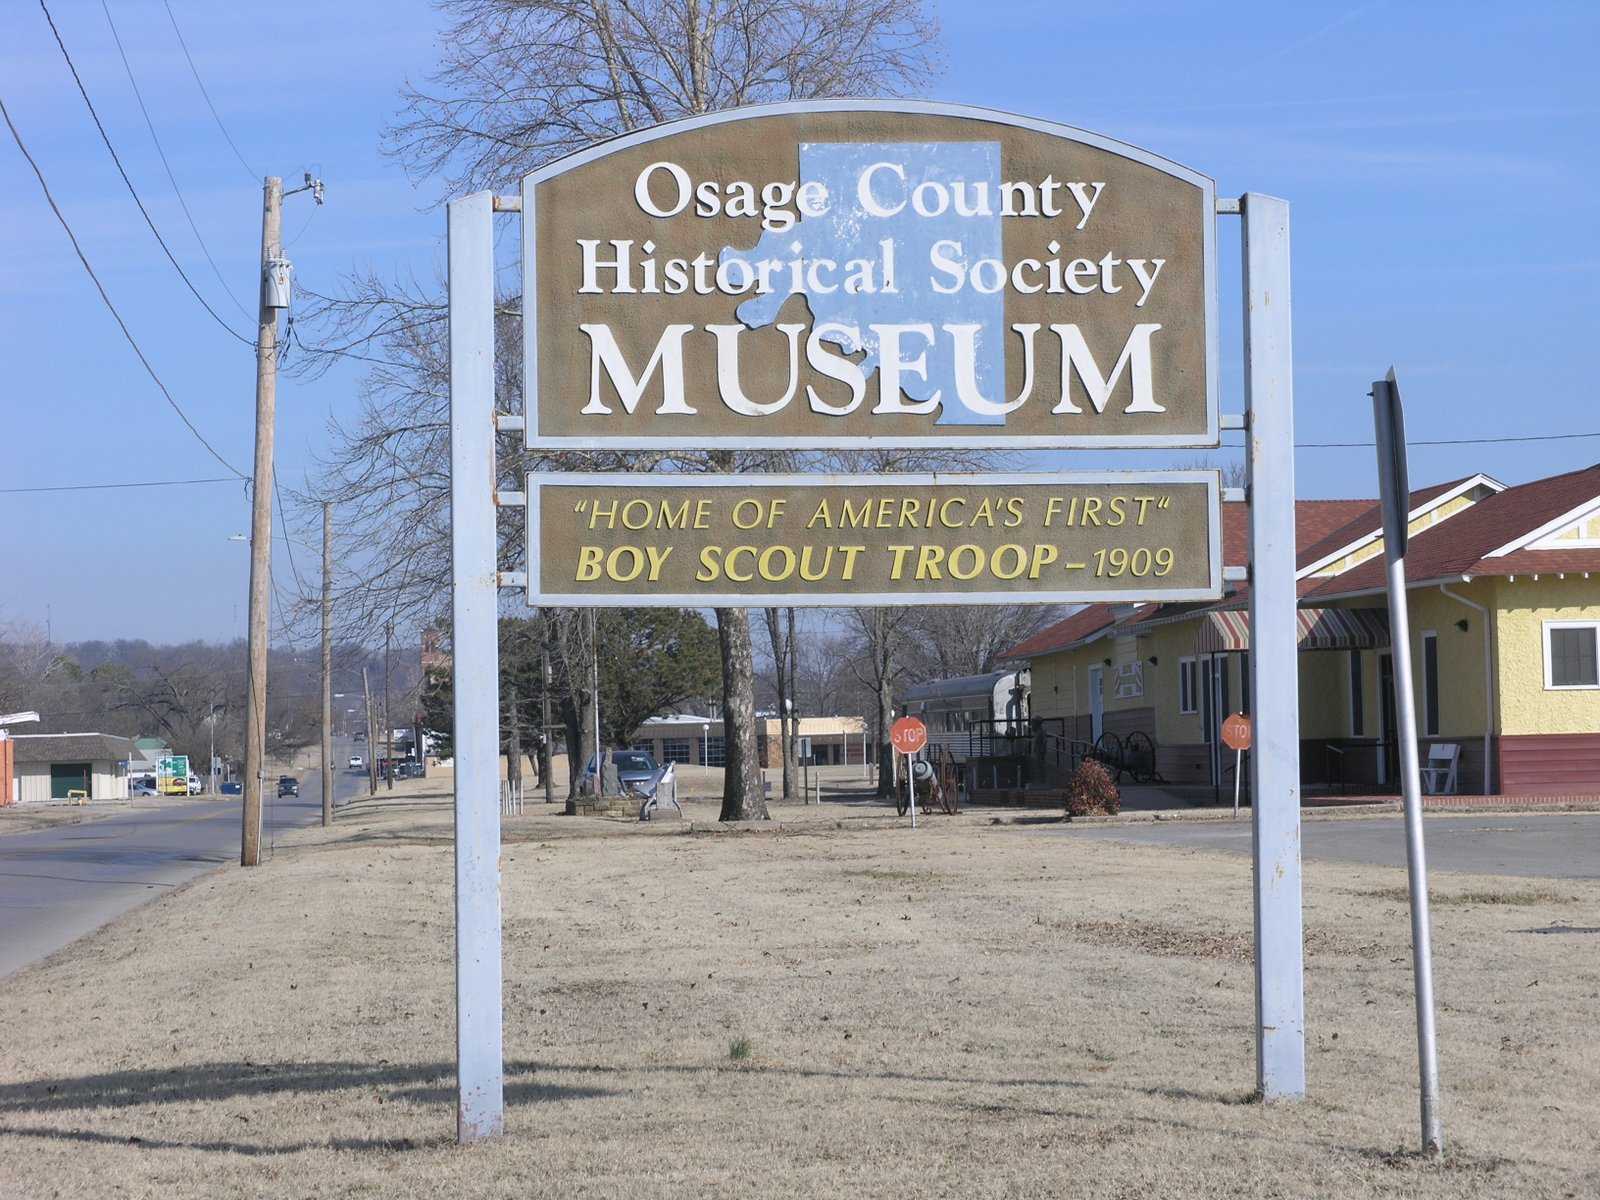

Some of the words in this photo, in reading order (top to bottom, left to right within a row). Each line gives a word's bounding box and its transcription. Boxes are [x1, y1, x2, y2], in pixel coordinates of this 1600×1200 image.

[634, 161, 828, 232] Osage
[856, 161, 1106, 230] County
[576, 239, 898, 295] Historical
[929, 239, 1166, 307] Society
[578, 322, 1167, 416] MUSEUM
[731, 498, 787, 529] OF
[806, 497, 1024, 528] AMERICA'S
[575, 545, 674, 582] BOY
[695, 545, 866, 582] SCOUT
[894, 728, 923, 743] STOP
